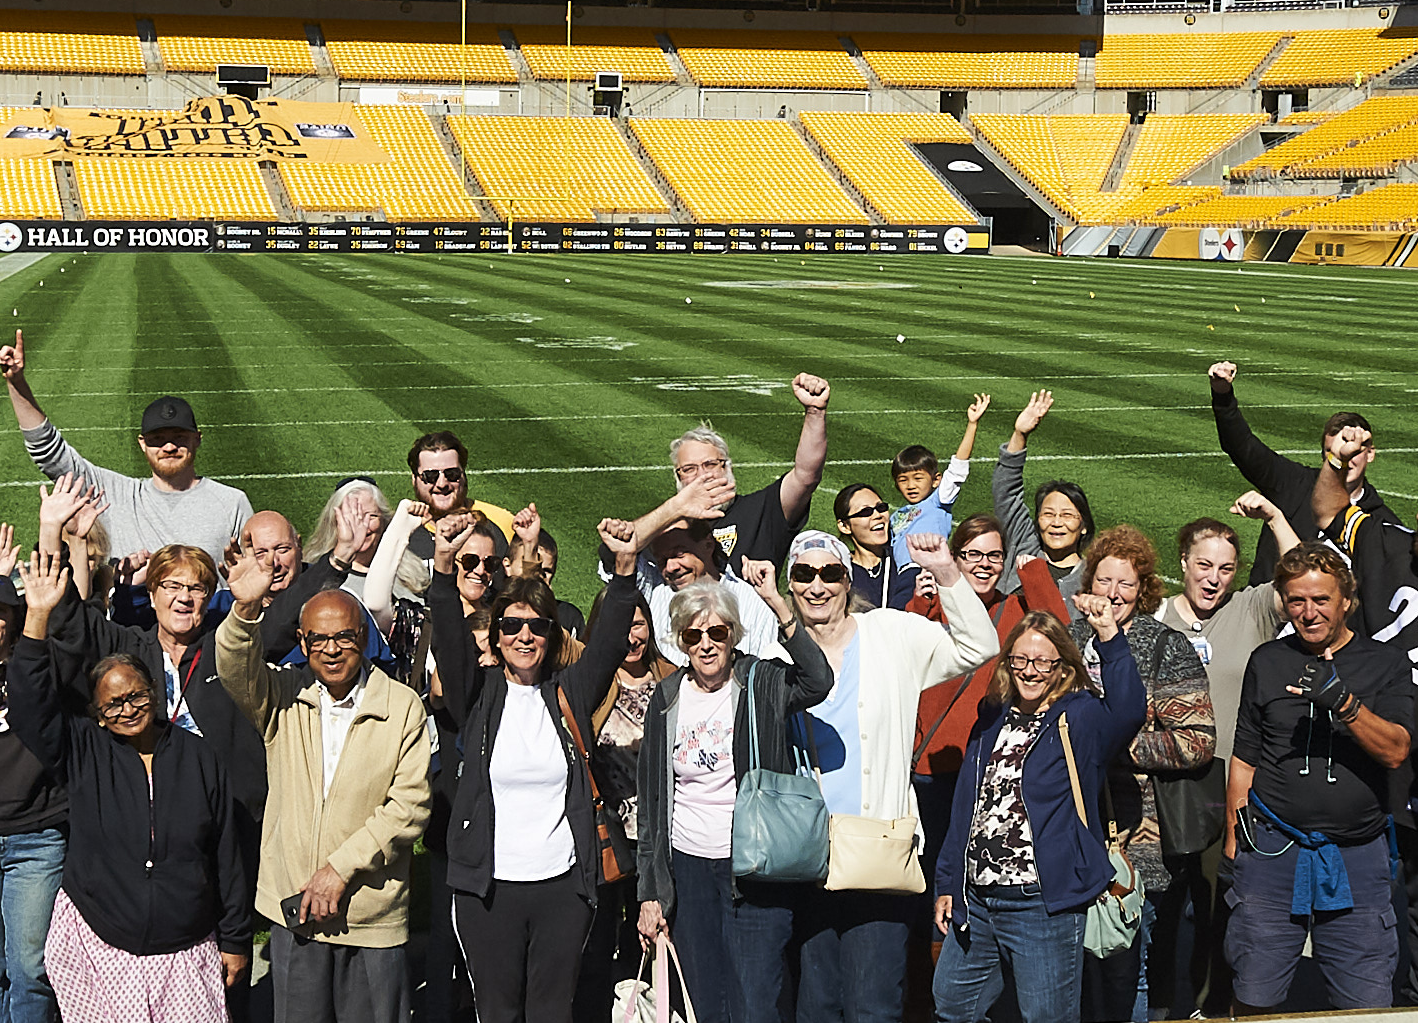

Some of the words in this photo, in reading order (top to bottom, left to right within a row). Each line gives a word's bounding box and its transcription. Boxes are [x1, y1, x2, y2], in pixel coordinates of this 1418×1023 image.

[268, 227, 276, 235] 15
[351, 227, 361, 235] 70
[433, 227, 443, 235] 47
[761, 229, 770, 237] 34
[27, 228, 89, 247] HALL
[93, 228, 123, 247] OF
[127, 228, 210, 247] HONOR
[266, 240, 276, 248] 35
[436, 241, 443, 249] 12
[522, 241, 531, 249] 52
